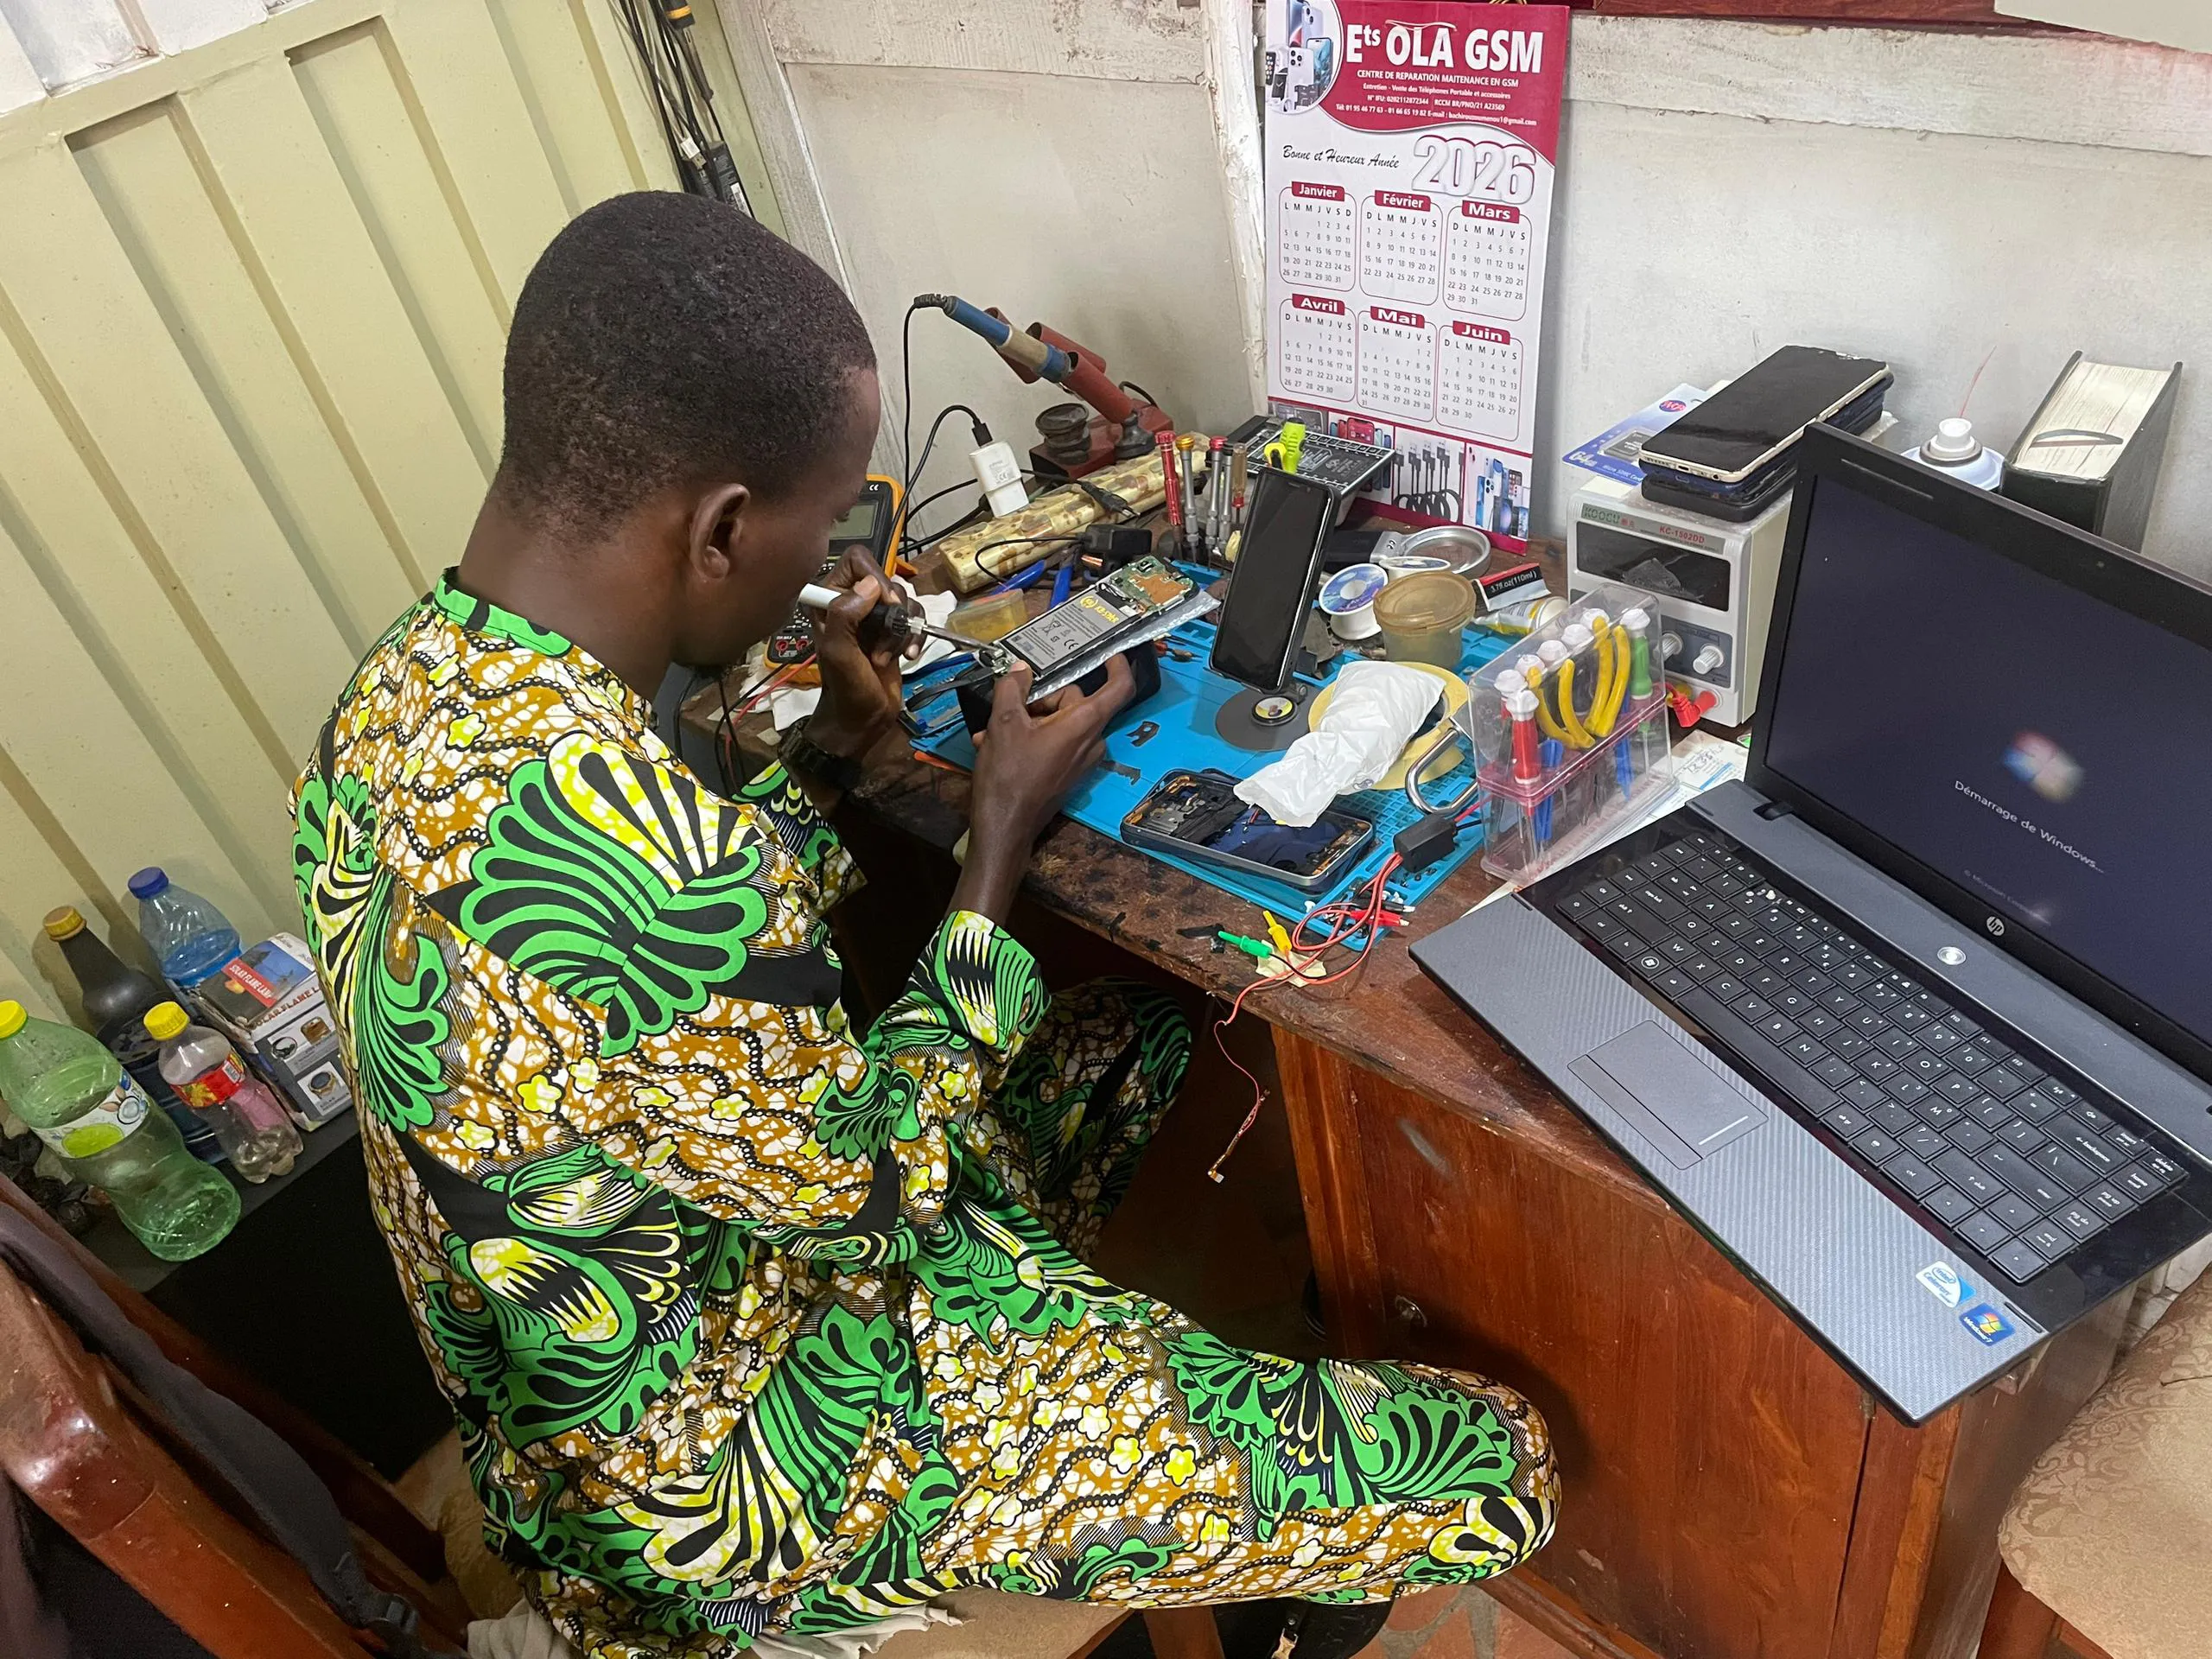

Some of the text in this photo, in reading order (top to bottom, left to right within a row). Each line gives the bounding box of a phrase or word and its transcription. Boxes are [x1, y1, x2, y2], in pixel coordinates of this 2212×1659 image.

[1346, 23, 1543, 73] Ets OLA GSM
[1357, 69, 1383, 79] CENTRE
[1385, 71, 1394, 79] DE
[1395, 72, 1440, 82] REPARATION
[1441, 74, 1489, 86] MAITENANCE
[1502, 79, 1519, 87] GSM
[1282, 145, 1400, 168] Bonne et Heureux Année
[1412, 134, 1536, 204] 2026
[1300, 183, 1337, 198] Janvier
[1382, 193, 1424, 208] Février
[1469, 203, 1510, 219] Mars
[1300, 297, 1338, 313] Avril
[1377, 308, 1416, 326] Mai
[1461, 325, 1503, 342] Juin
[1659, 525, 1705, 544] KC-1502DD
[1955, 780, 2018, 823] Démarrage
[2021, 820, 2037, 833] de
[1987, 916, 2004, 935] hp
[1672, 943, 1684, 952] W
[229, 964, 247, 982] SOLAR
[244, 974, 264, 994] FLAME
[1813, 1017, 1825, 1026] H
[1862, 1016, 1873, 1025] U
[1798, 1043, 1811, 1052] N
[1919, 1060, 1931, 1069] O
[1929, 1106, 1942, 1116] M
